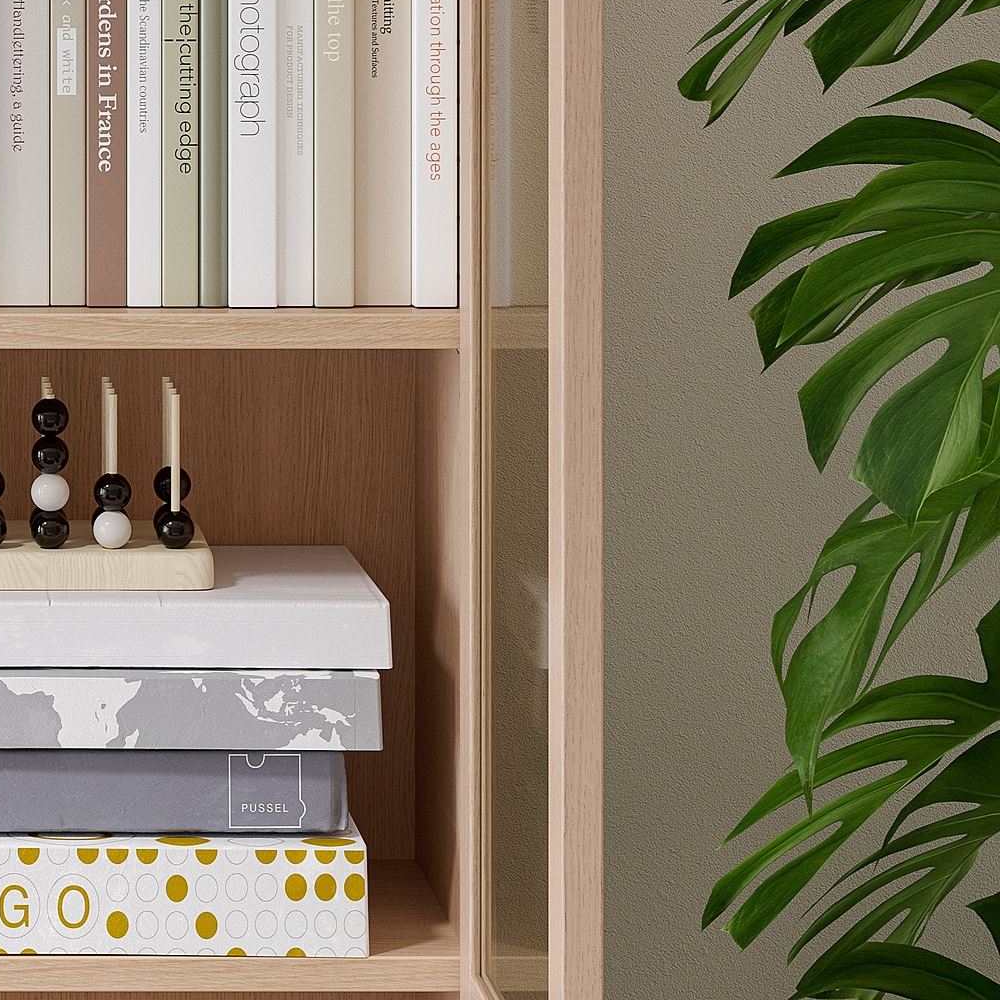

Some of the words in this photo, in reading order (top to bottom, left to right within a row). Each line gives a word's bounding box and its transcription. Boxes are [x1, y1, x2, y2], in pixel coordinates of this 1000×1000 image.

[62, 15, 74, 41] and
[179, 3, 198, 36] the
[371, 32, 379, 46] and
[138, 15, 151, 83] Scandinavian
[296, 25, 304, 100] MANUFACTURING
[323, 32, 343, 62] top
[371, 47, 379, 78] Surfaces
[62, 49, 74, 93] white
[98, 64, 118, 87] in
[174, 43, 197, 114] cutting
[425, 41, 446, 106] through
[12, 101, 21, 109] a
[138, 85, 150, 134] countries
[429, 111, 446, 137] the
[9, 113, 25, 152] guide
[97, 93, 118, 173] France
[174, 121, 198, 174] edge
[296, 101, 304, 156] TECHNIQUES
[425, 142, 442, 181] ages
[241, 803, 289, 813] PUSSEL
